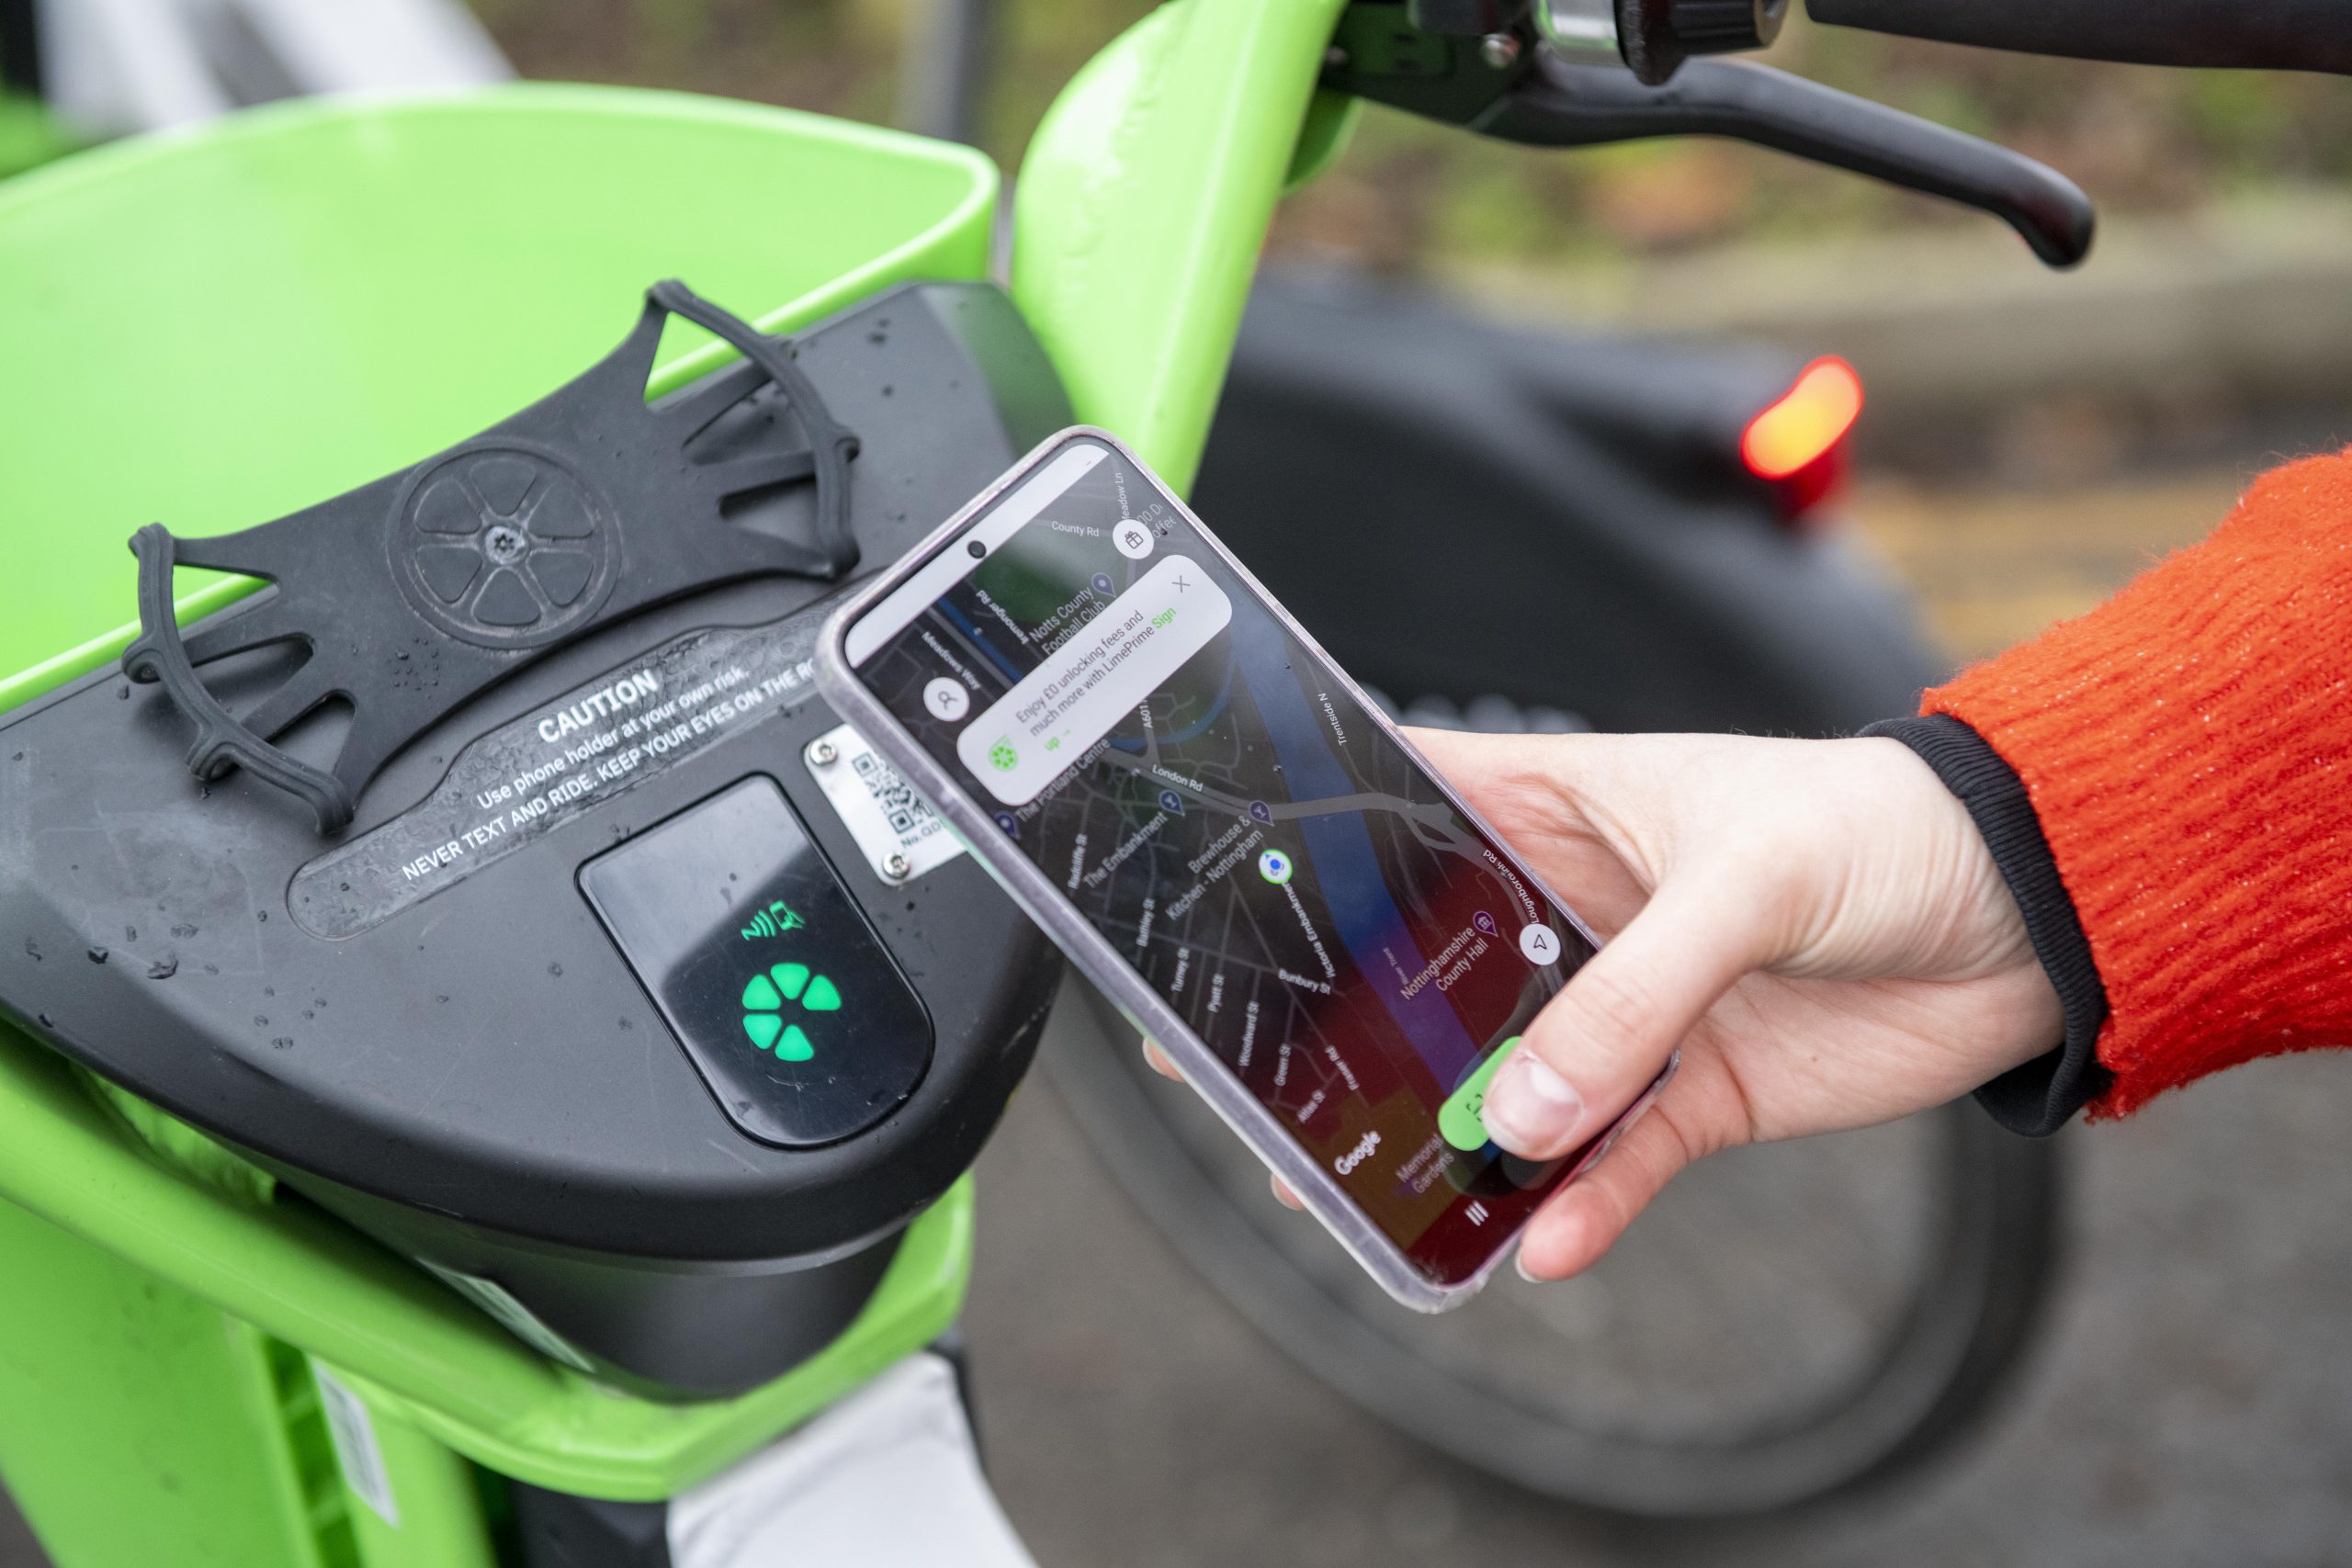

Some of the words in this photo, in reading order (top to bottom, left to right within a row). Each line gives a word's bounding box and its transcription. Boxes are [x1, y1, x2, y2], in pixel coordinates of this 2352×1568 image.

[1114, 472, 1124, 483] Ln
[1051, 521, 1085, 536] County
[1087, 525, 1100, 536] Rd
[976, 589, 989, 605] Rd
[1028, 614, 1060, 643] Notts
[1057, 587, 1094, 619] County
[1042, 620, 1082, 655] Football
[1080, 600, 1106, 627] Club
[921, 631, 963, 677] Meadows
[961, 668, 982, 692] Way
[1015, 695, 1046, 725] Enjoy
[1044, 683, 1059, 700] £0
[1057, 646, 1106, 687] unlocking
[1101, 628, 1125, 650] fees
[1124, 610, 1144, 632] and
[1030, 711, 1060, 737] much
[1058, 687, 1086, 713] more
[1083, 668, 1106, 690] with
[1102, 625, 1155, 675] LimePrime
[1150, 607, 1176, 629] Sign
[538, 669, 660, 744] CAUTION
[1317, 692, 1329, 702] N
[476, 783, 513, 810] Use
[513, 754, 566, 795] phone
[564, 725, 620, 764] holder
[620, 716, 640, 739] at
[639, 699, 680, 731] your
[678, 682, 713, 709] own
[713, 665, 750, 692] risk.
[1045, 736, 1060, 752] up
[1324, 702, 1347, 746] Trentside
[401, 840, 464, 881] NEVER
[461, 816, 506, 850] TEXT
[511, 795, 548, 828] AND
[596, 749, 645, 784] KEEP
[641, 722, 693, 759] YOUR
[690, 702, 735, 735] EYES
[734, 689, 763, 713] ON
[761, 668, 798, 698] THE
[1014, 800, 1040, 822] The
[1035, 765, 1080, 807] Portland
[1076, 738, 1112, 770] Centre
[1151, 764, 1189, 787] London
[1188, 779, 1204, 793] Rd
[1082, 867, 1108, 889] The
[1102, 811, 1169, 873] Embankment
[1187, 822, 1243, 874] Brewhouse
[1238, 815, 1252, 828] &
[1482, 849, 1498, 864] Rd
[1165, 883, 1206, 921] Kitchen
[1205, 829, 1264, 883] Nottingham
[1282, 881, 1318, 942] Embankmen
[1177, 946, 1191, 958] St
[1400, 927, 1476, 1000] Nottinghamshire
[1435, 959, 1472, 992] County
[1466, 937, 1489, 963] Hall
[1212, 973, 1225, 986] St
[1278, 967, 1320, 992] Bunbury
[1319, 981, 1331, 995] St
[1247, 1000, 1260, 1014] St
[1279, 1043, 1291, 1056] St
[1334, 1130, 1381, 1176] Google
[1396, 1133, 1444, 1183] Memorial
[1411, 1151, 1454, 1193] Gardens
